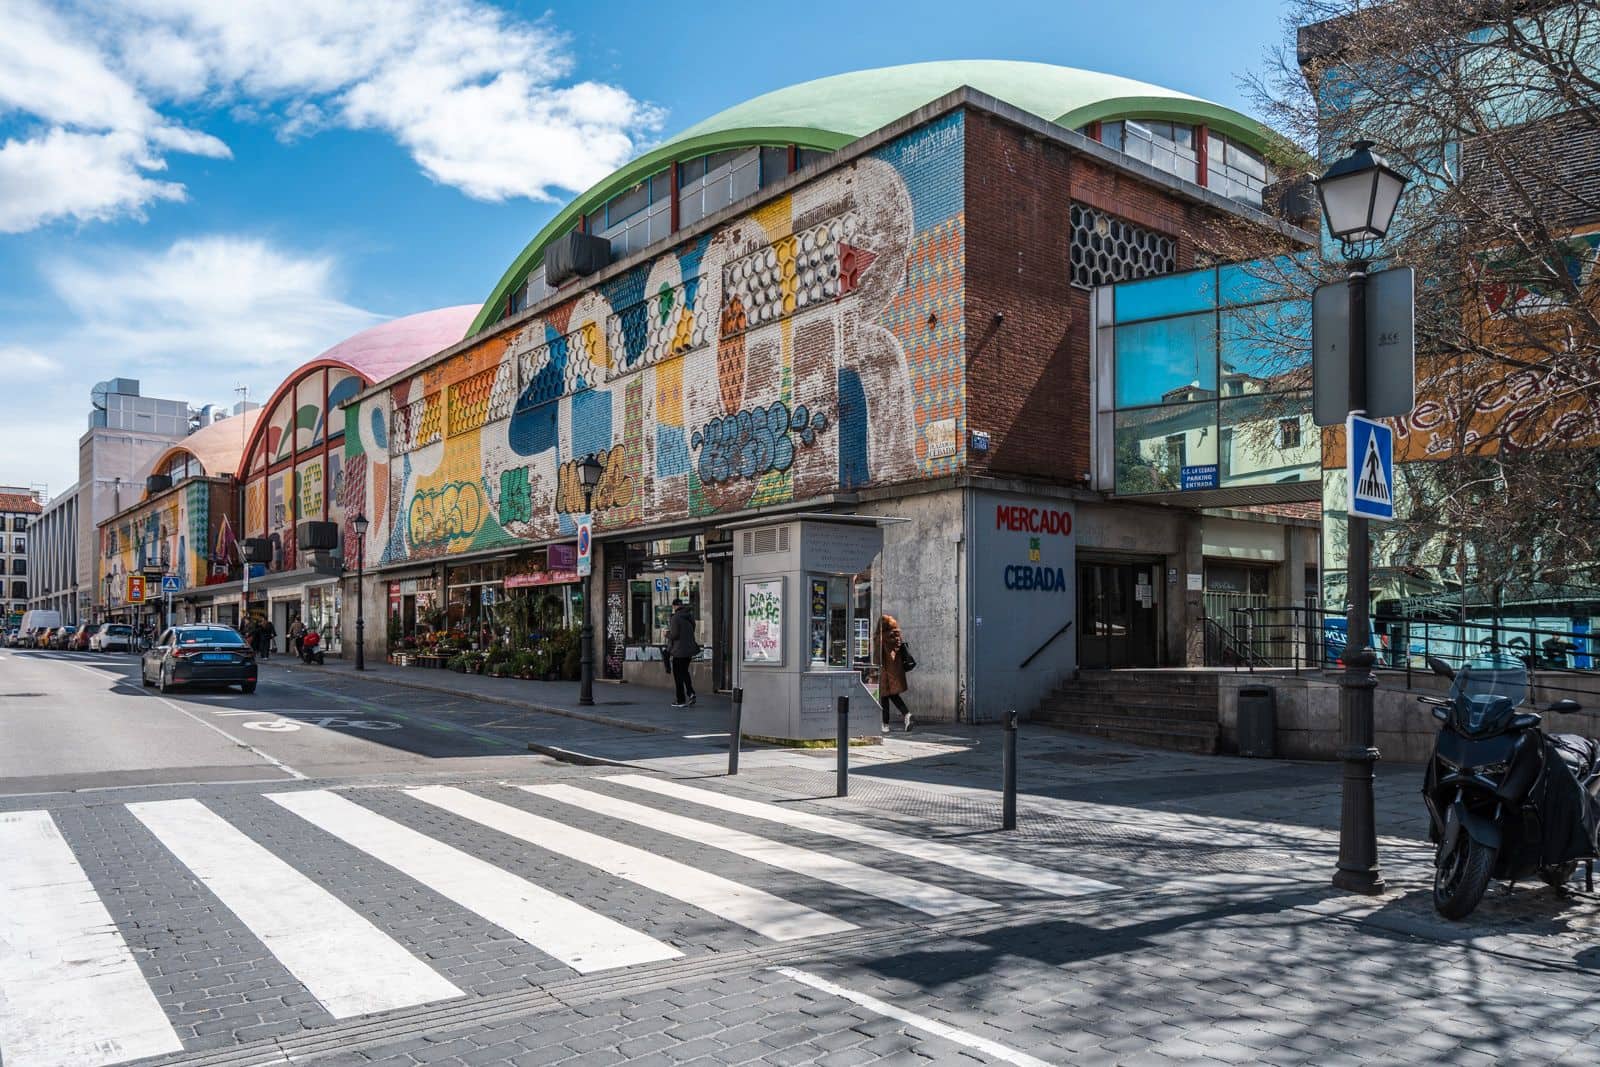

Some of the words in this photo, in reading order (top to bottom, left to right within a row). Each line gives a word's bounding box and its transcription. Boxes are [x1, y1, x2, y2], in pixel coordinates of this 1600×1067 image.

[1198, 466, 1217, 474] CEBADA
[1185, 481, 1213, 489] ENTRADA
[996, 504, 1072, 536] MERCADO
[1030, 537, 1041, 549] DE
[1004, 565, 1066, 592] CEBADA
